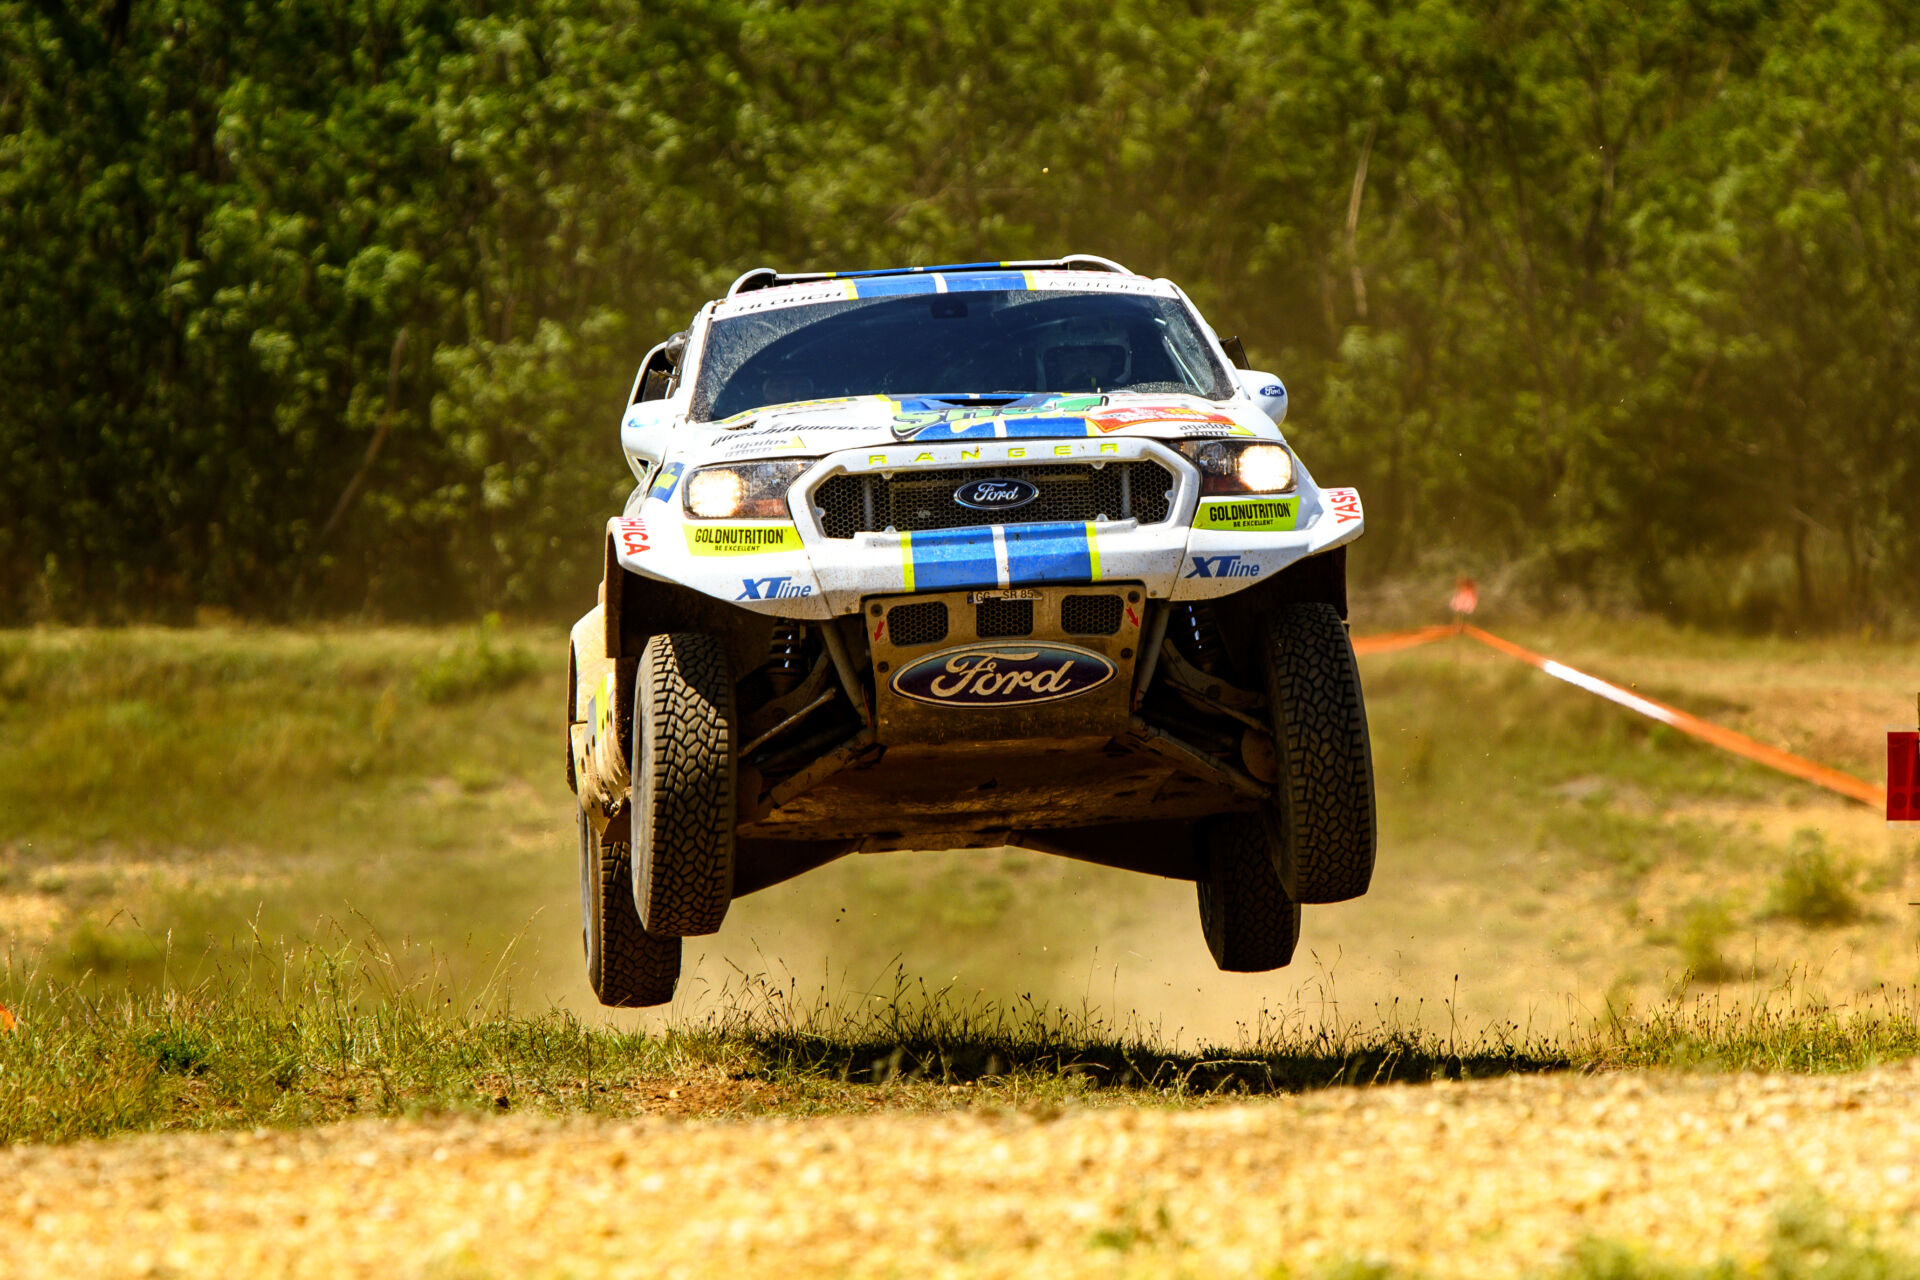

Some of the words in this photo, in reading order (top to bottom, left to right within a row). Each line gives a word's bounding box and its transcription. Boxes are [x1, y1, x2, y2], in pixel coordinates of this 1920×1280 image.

[1264, 385, 1282, 396] Ford
[868, 442, 1119, 466] RANGER
[973, 482, 1019, 502] Ford
[1209, 502, 1291, 522] GOLDNUTRITION
[1243, 519, 1274, 527] EXCELLENT
[694, 528, 784, 544] GOLDNUTRITION
[1184, 555, 1260, 579] XTline
[736, 576, 812, 600] XTline
[1002, 590, 1018, 601] SR
[930, 651, 1075, 697] Ford
